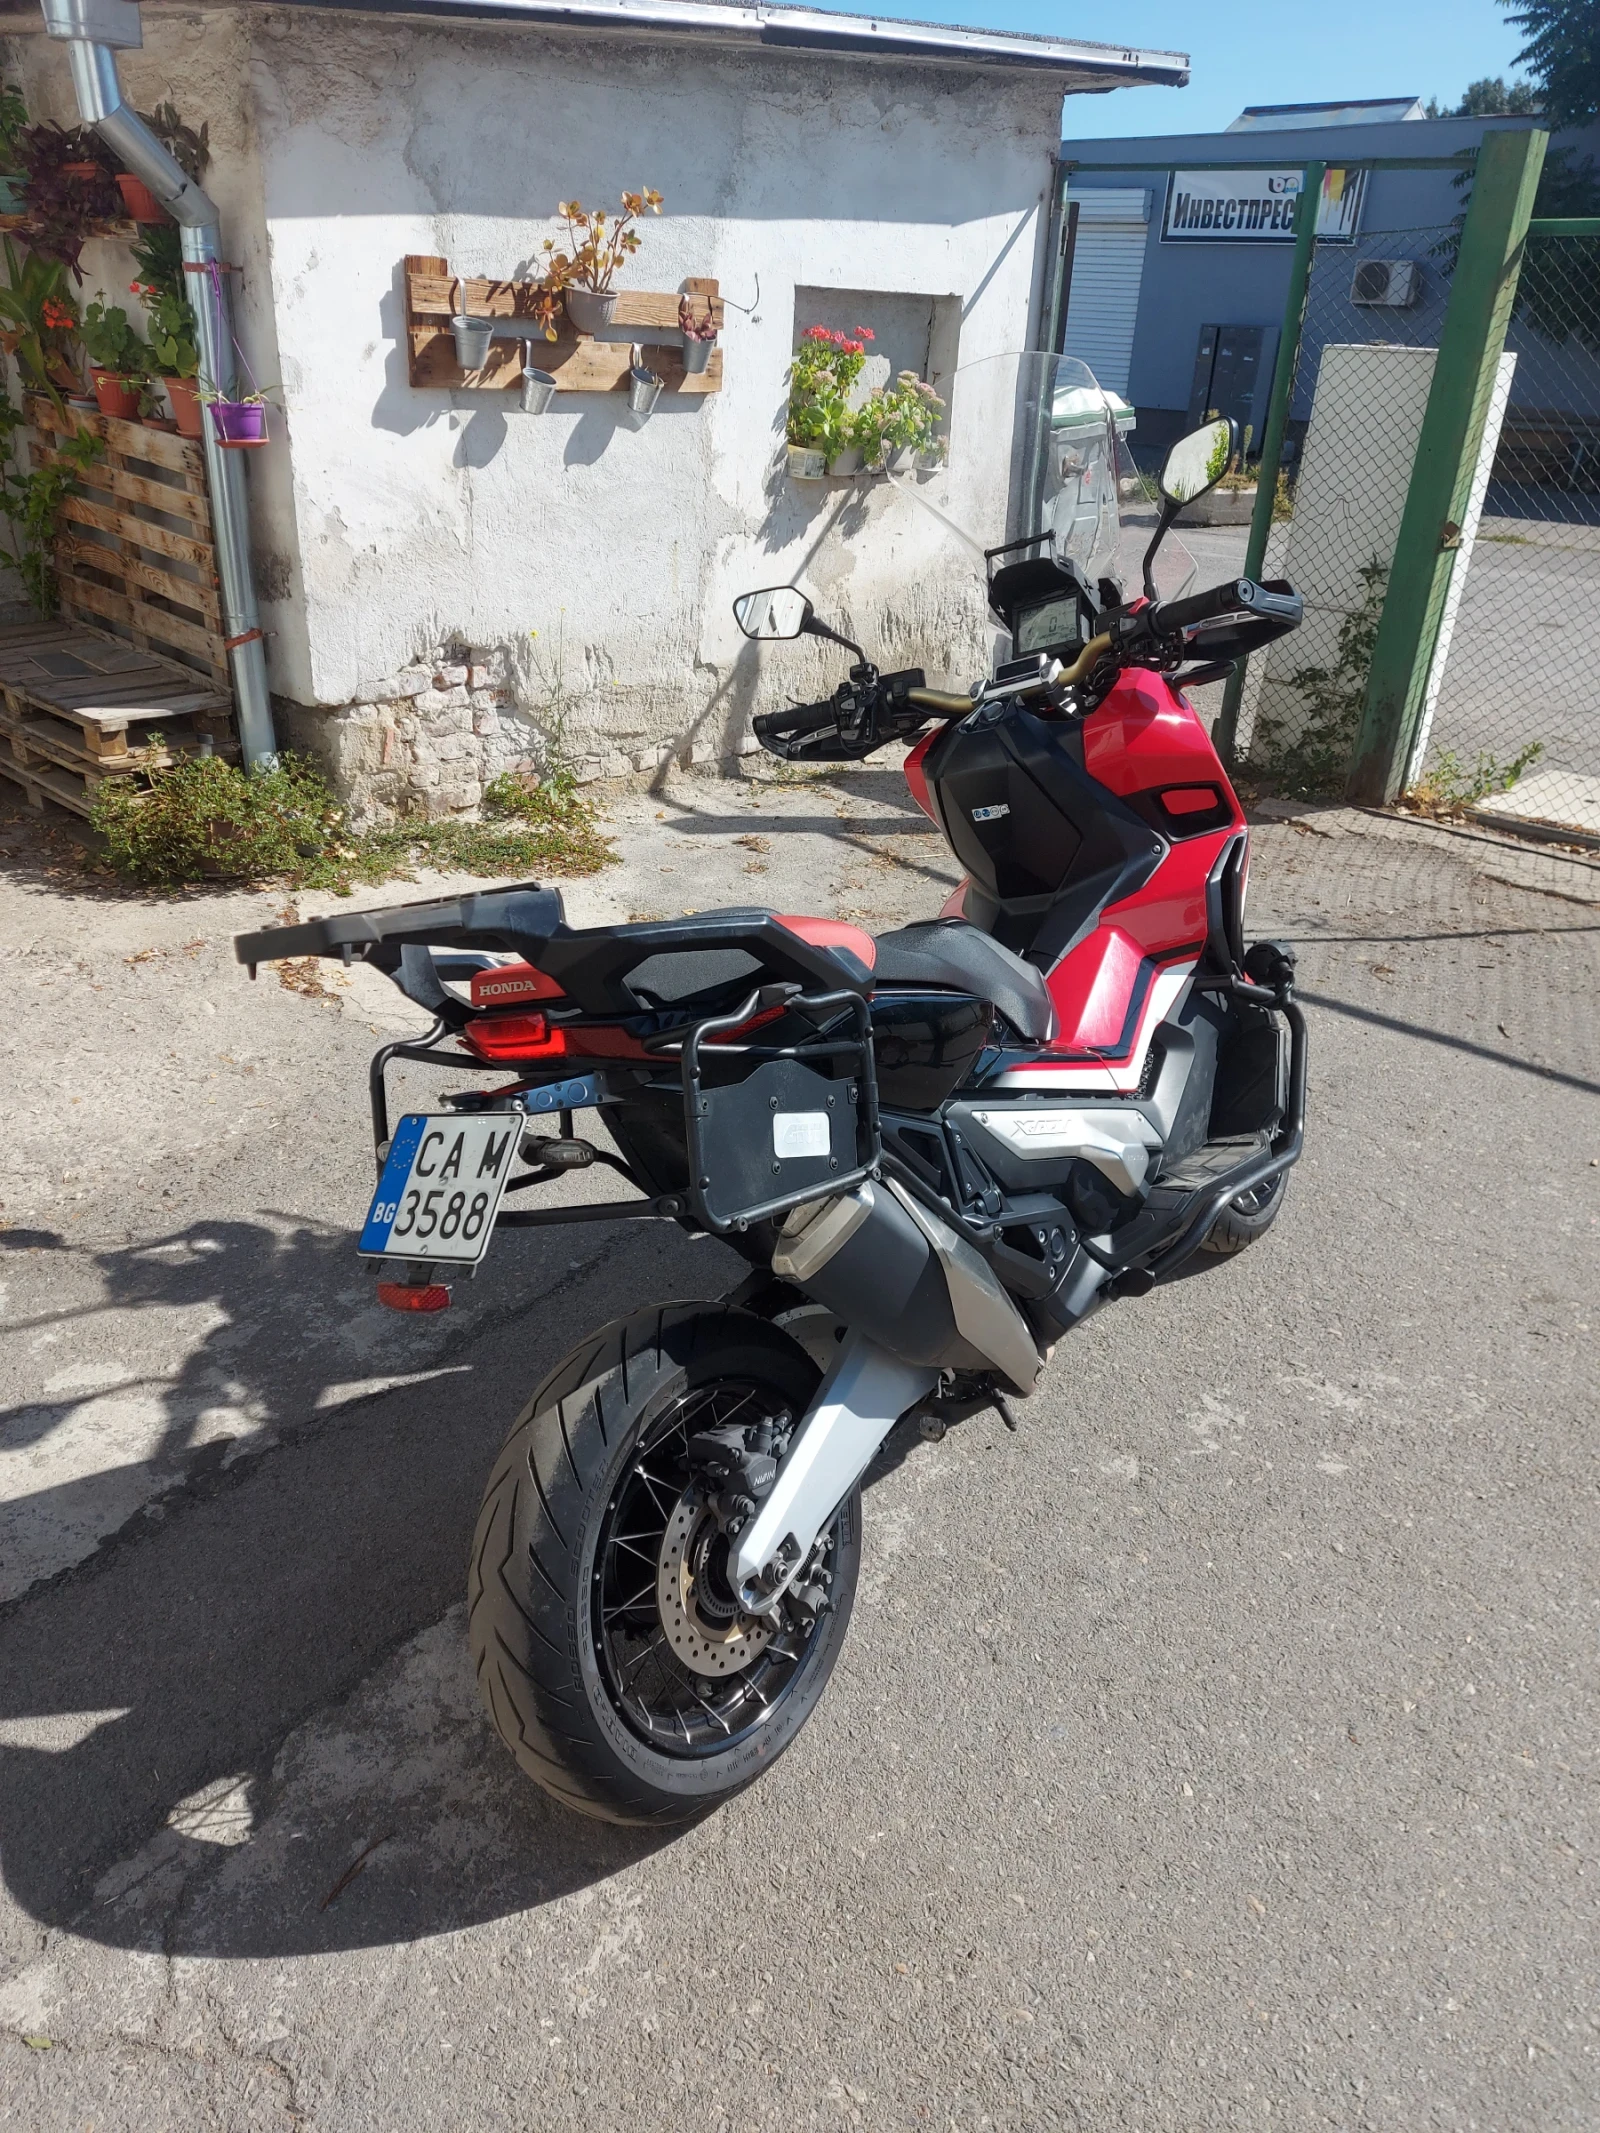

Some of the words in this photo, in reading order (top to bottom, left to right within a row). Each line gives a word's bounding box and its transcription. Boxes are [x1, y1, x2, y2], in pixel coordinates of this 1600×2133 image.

[479, 980, 537, 997] HONDA
[372, 1202, 397, 1224] BG
[394, 1189, 490, 1241] 3588
